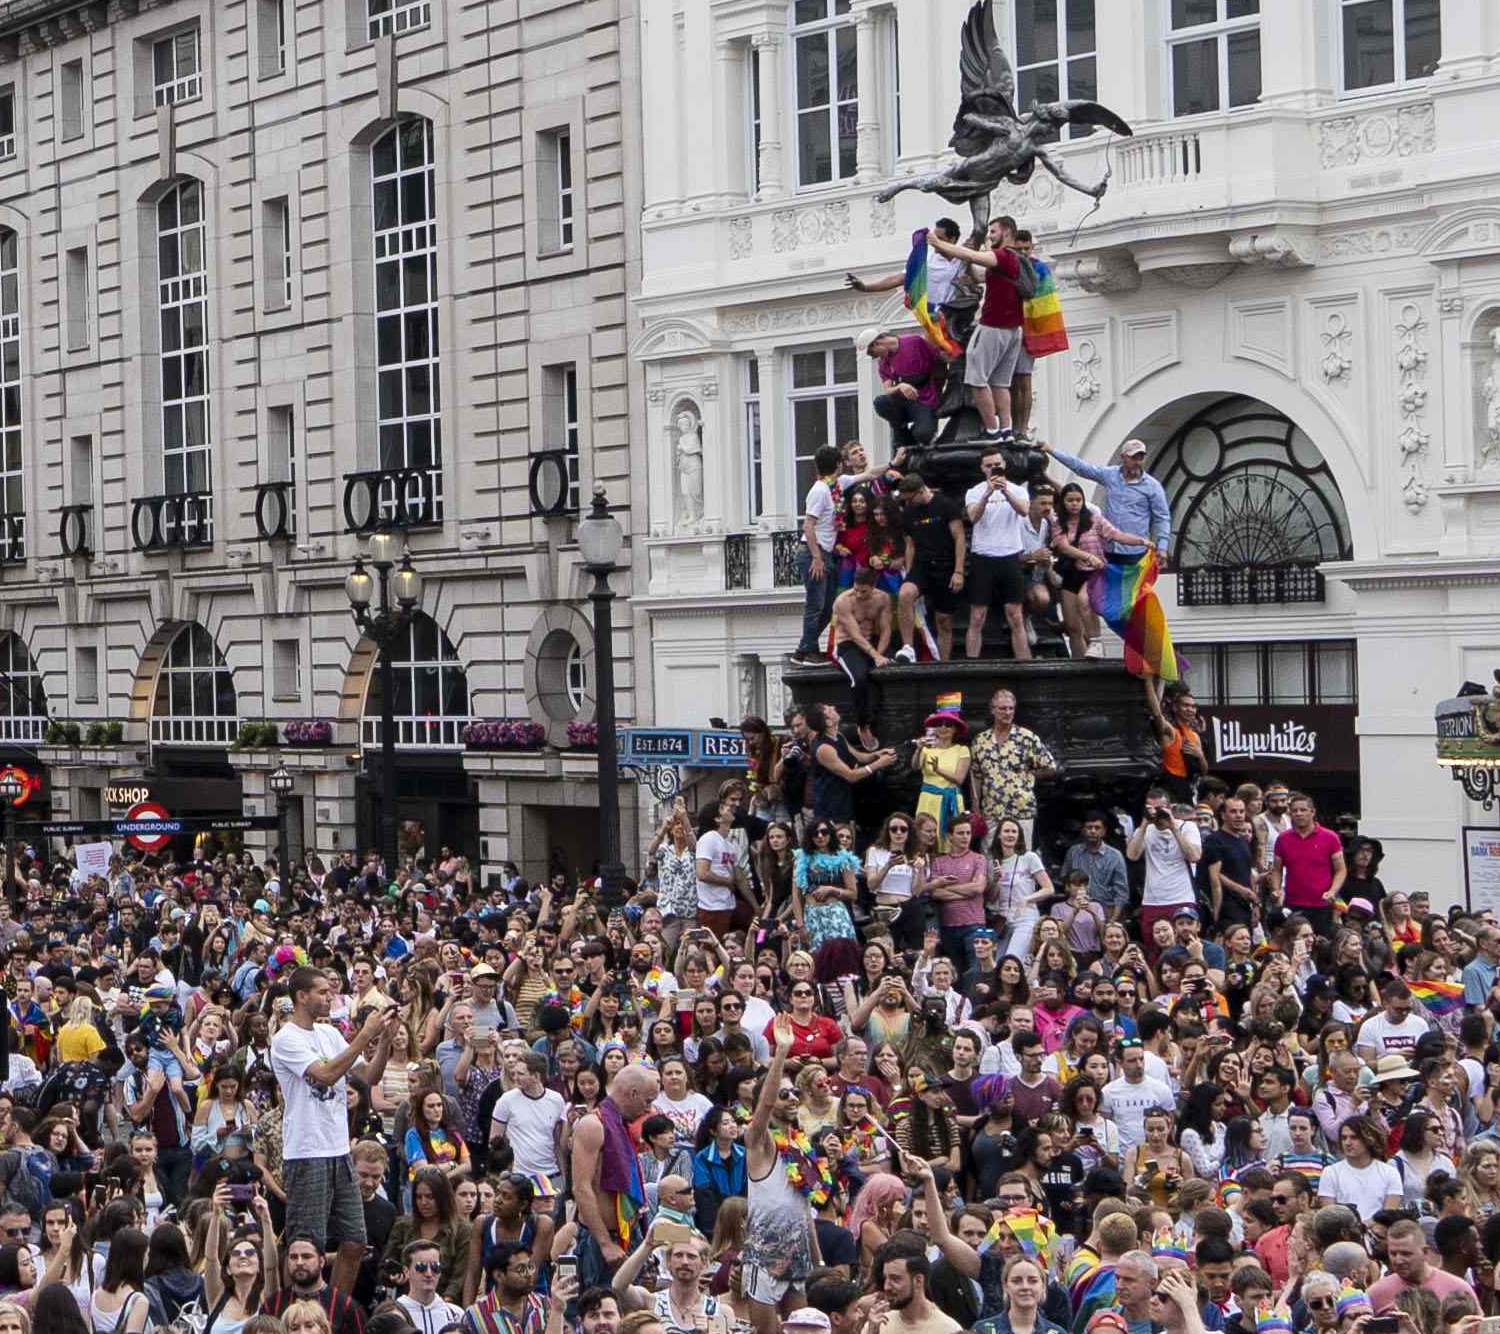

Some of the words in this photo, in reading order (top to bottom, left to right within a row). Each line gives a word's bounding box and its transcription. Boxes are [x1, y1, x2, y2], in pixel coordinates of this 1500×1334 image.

[1213, 716, 1318, 763] Lillywhites
[119, 787, 149, 803] SHOP
[117, 822, 181, 833] UNDERGROUND
[1471, 846, 1488, 857] BANK
